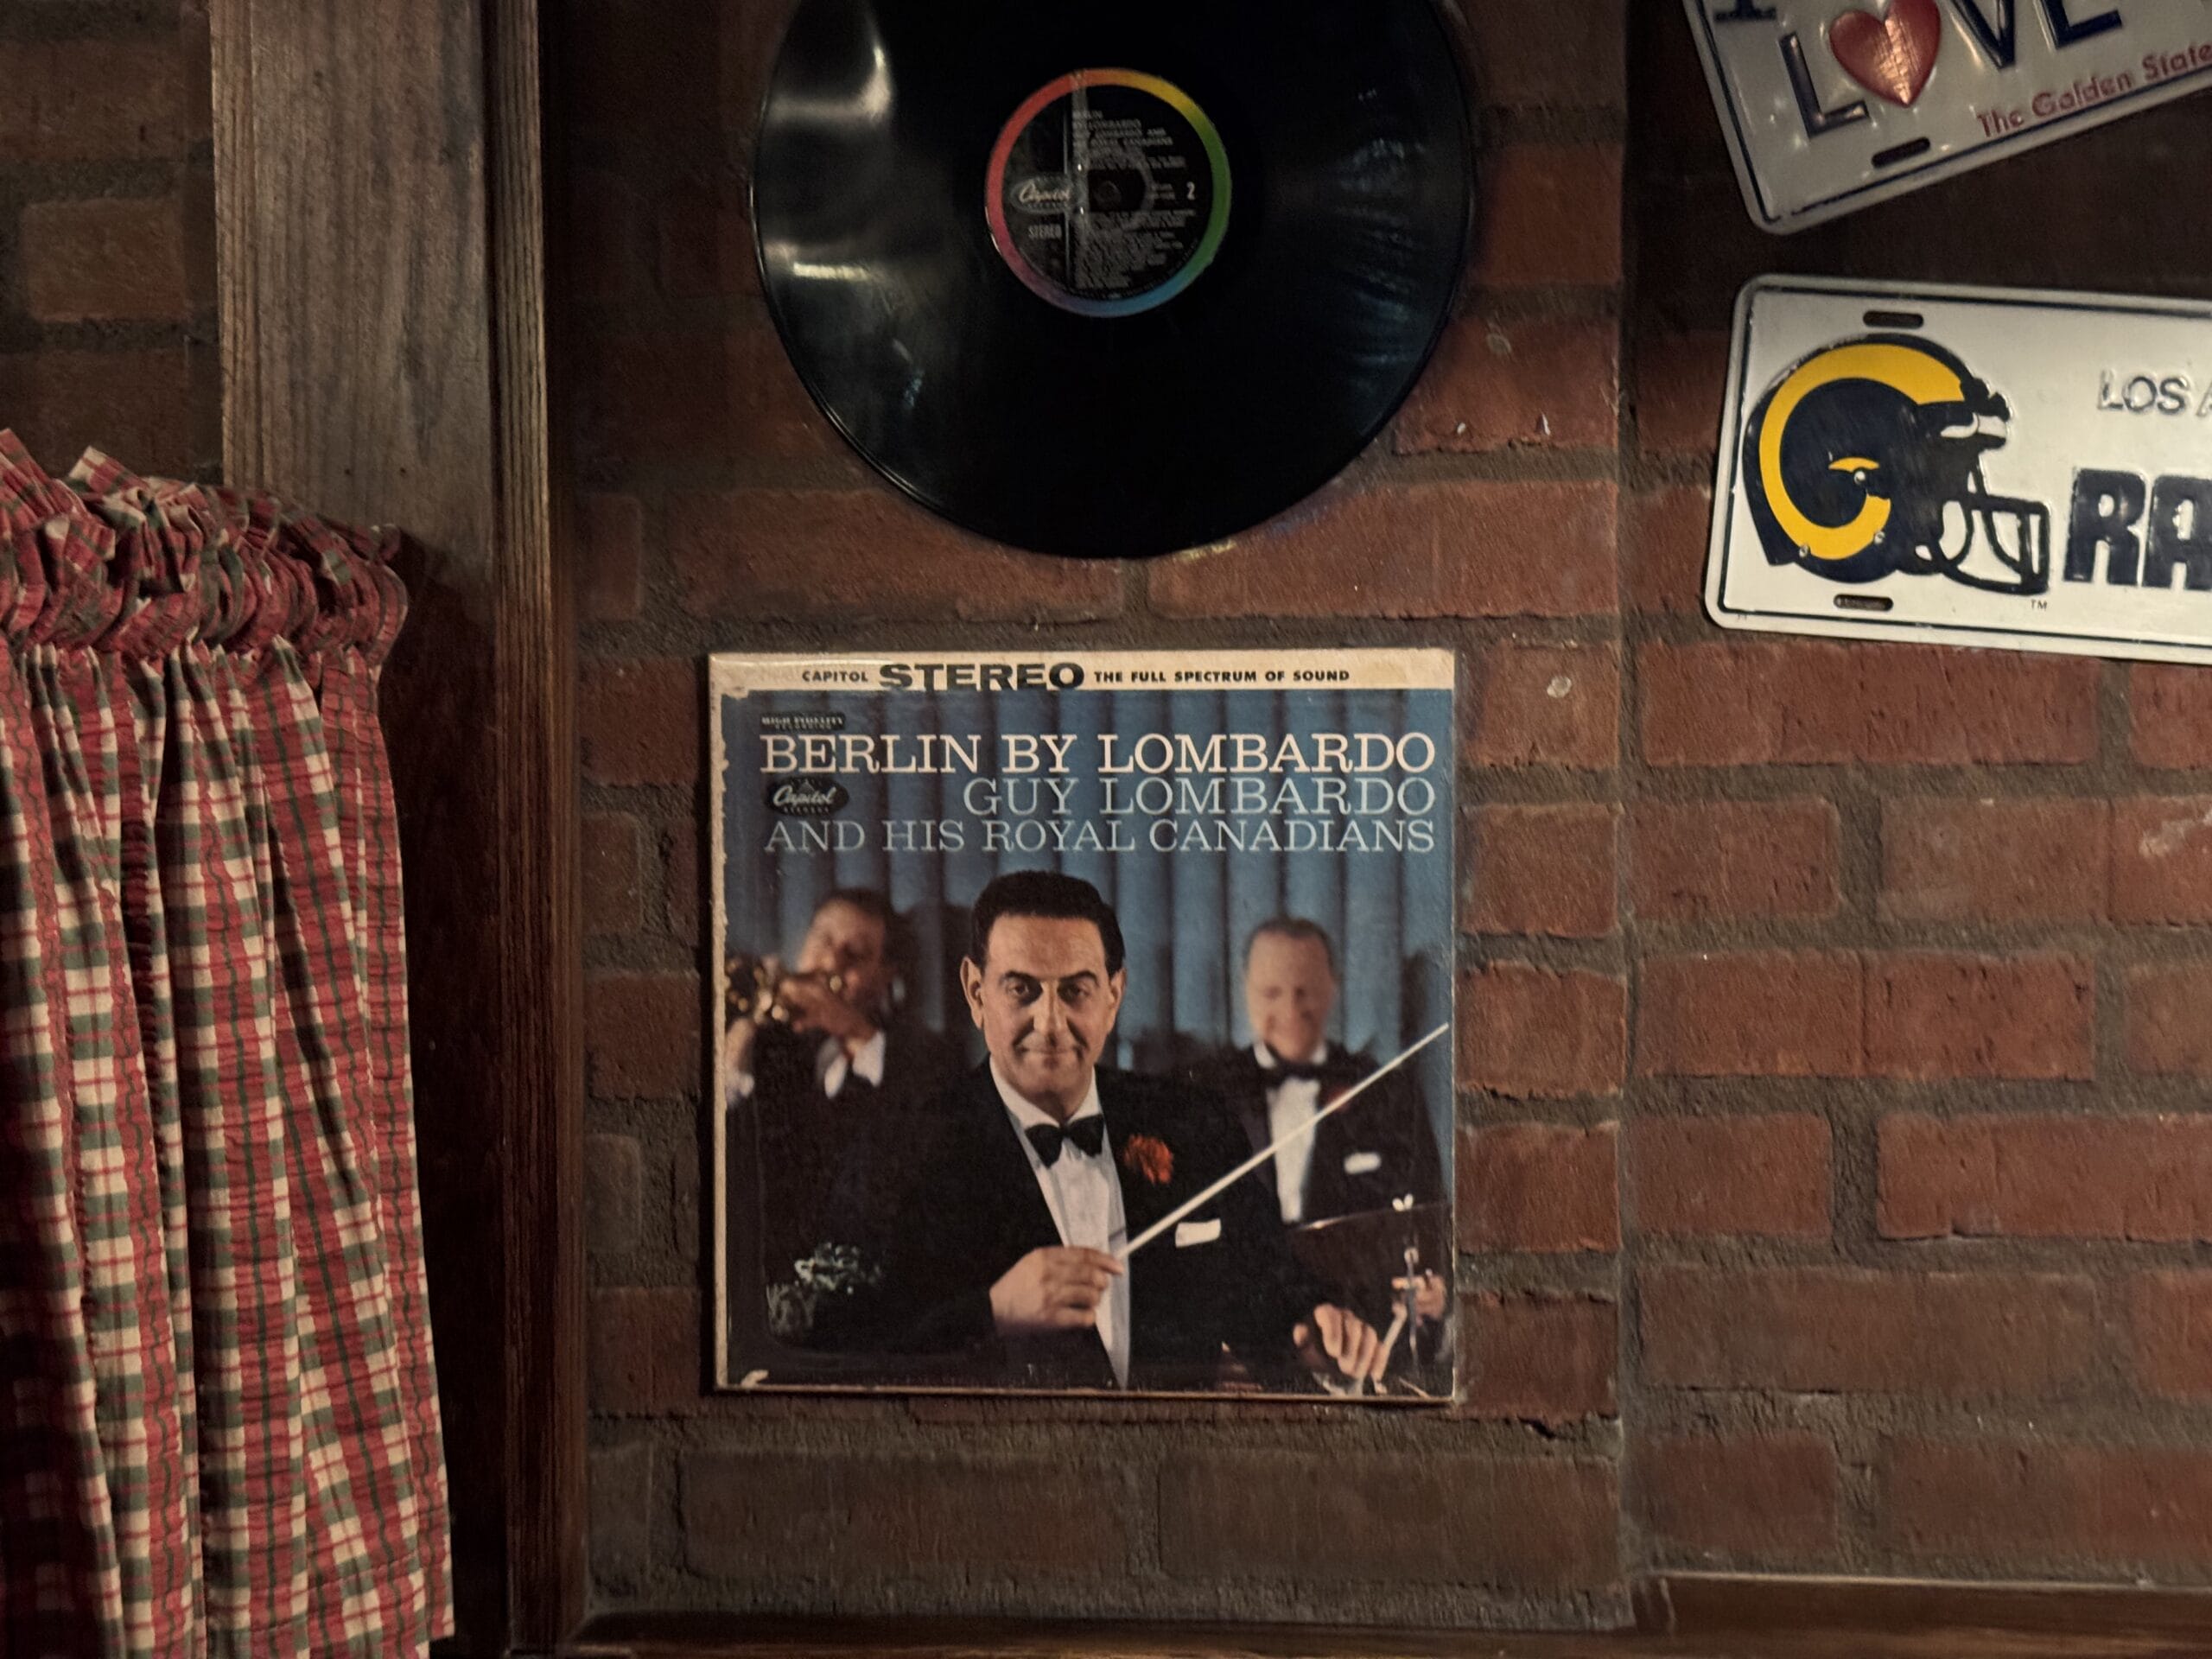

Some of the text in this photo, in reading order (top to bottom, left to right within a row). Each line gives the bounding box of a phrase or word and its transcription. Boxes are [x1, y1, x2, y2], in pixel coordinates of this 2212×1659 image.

[1977, 41, 2212, 138] The Golden State
[1186, 181, 1196, 200] 2
[2096, 370, 2190, 415] LOS
[802, 663, 1351, 691] CAPITOL STEREO THE FULL SPECTRUM OF SOUND
[760, 732, 1436, 773] BERLIN BY LOMBARDO
[772, 784, 837, 806] Capitol
[963, 777, 1436, 817] GUY LOMBARDO
[764, 818, 1435, 853] AND HIS ROYAL CANADIANS
